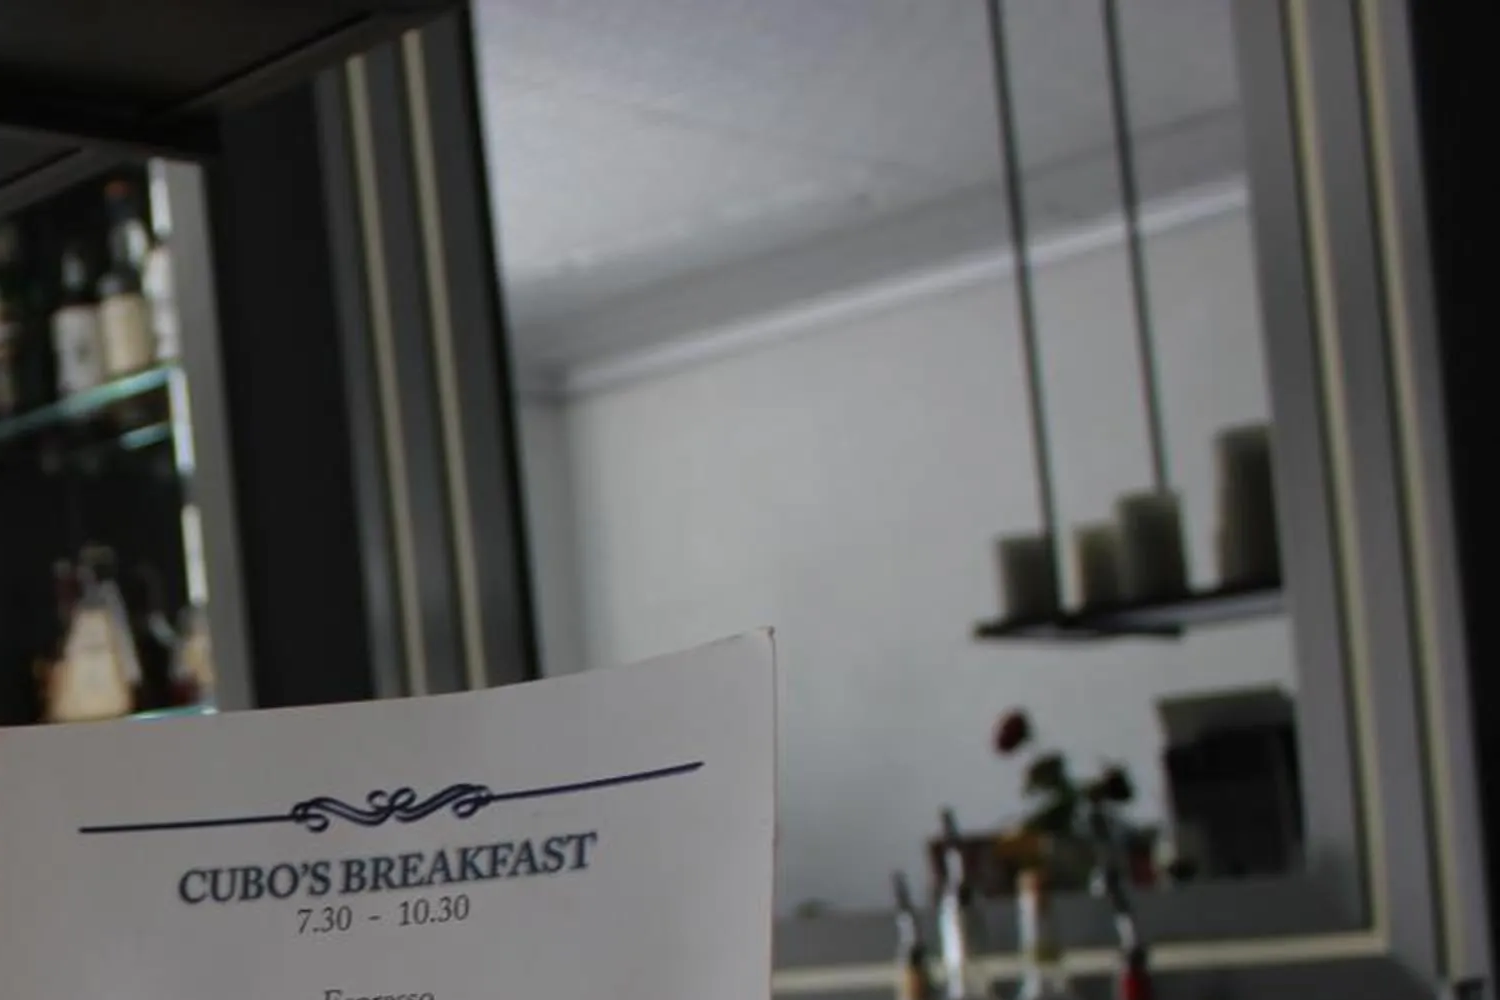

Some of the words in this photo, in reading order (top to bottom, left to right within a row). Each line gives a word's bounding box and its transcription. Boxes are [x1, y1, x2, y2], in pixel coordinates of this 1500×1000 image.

[177, 860, 331, 906] CUBO'S
[339, 831, 597, 895] BREAKFAST
[297, 906, 353, 934] 7.30
[399, 894, 470, 926] 10.30
